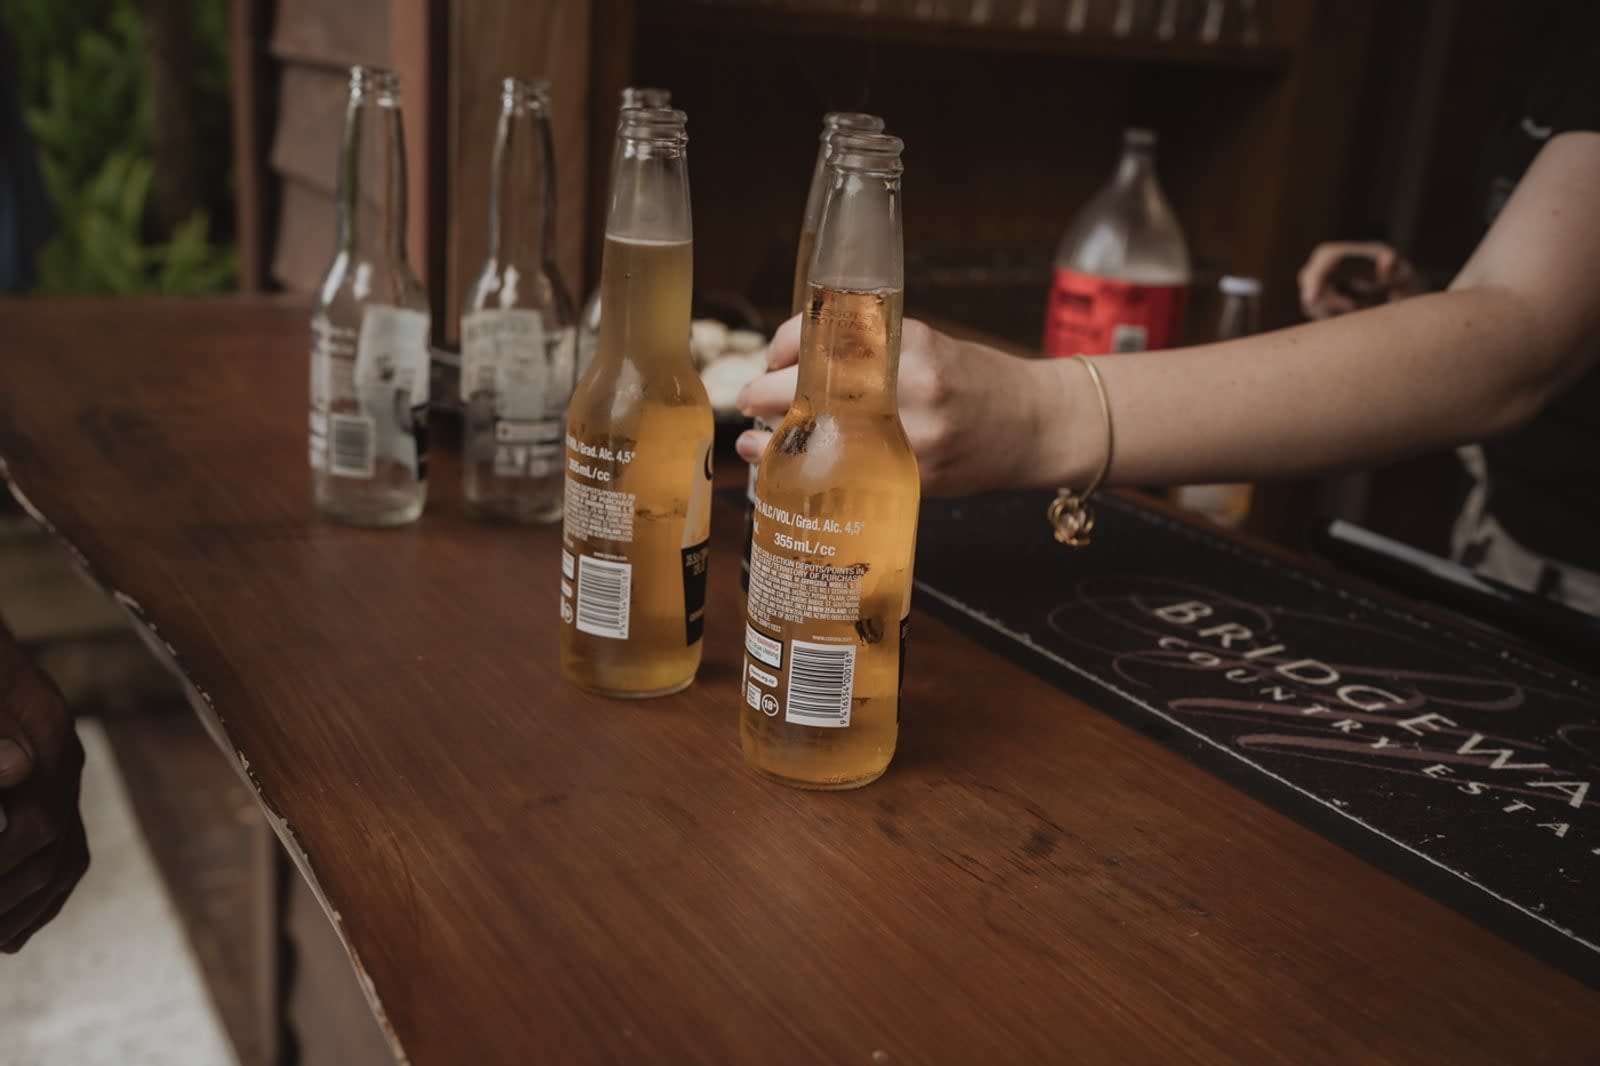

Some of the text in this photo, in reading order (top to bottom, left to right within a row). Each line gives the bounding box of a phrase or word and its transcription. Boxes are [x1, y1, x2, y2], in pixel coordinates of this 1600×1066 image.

[823, 519, 842, 533] Alc.
[1155, 600, 1591, 809] BRIDGEWA
[1158, 637, 1600, 856] COUNTRY ESTA
